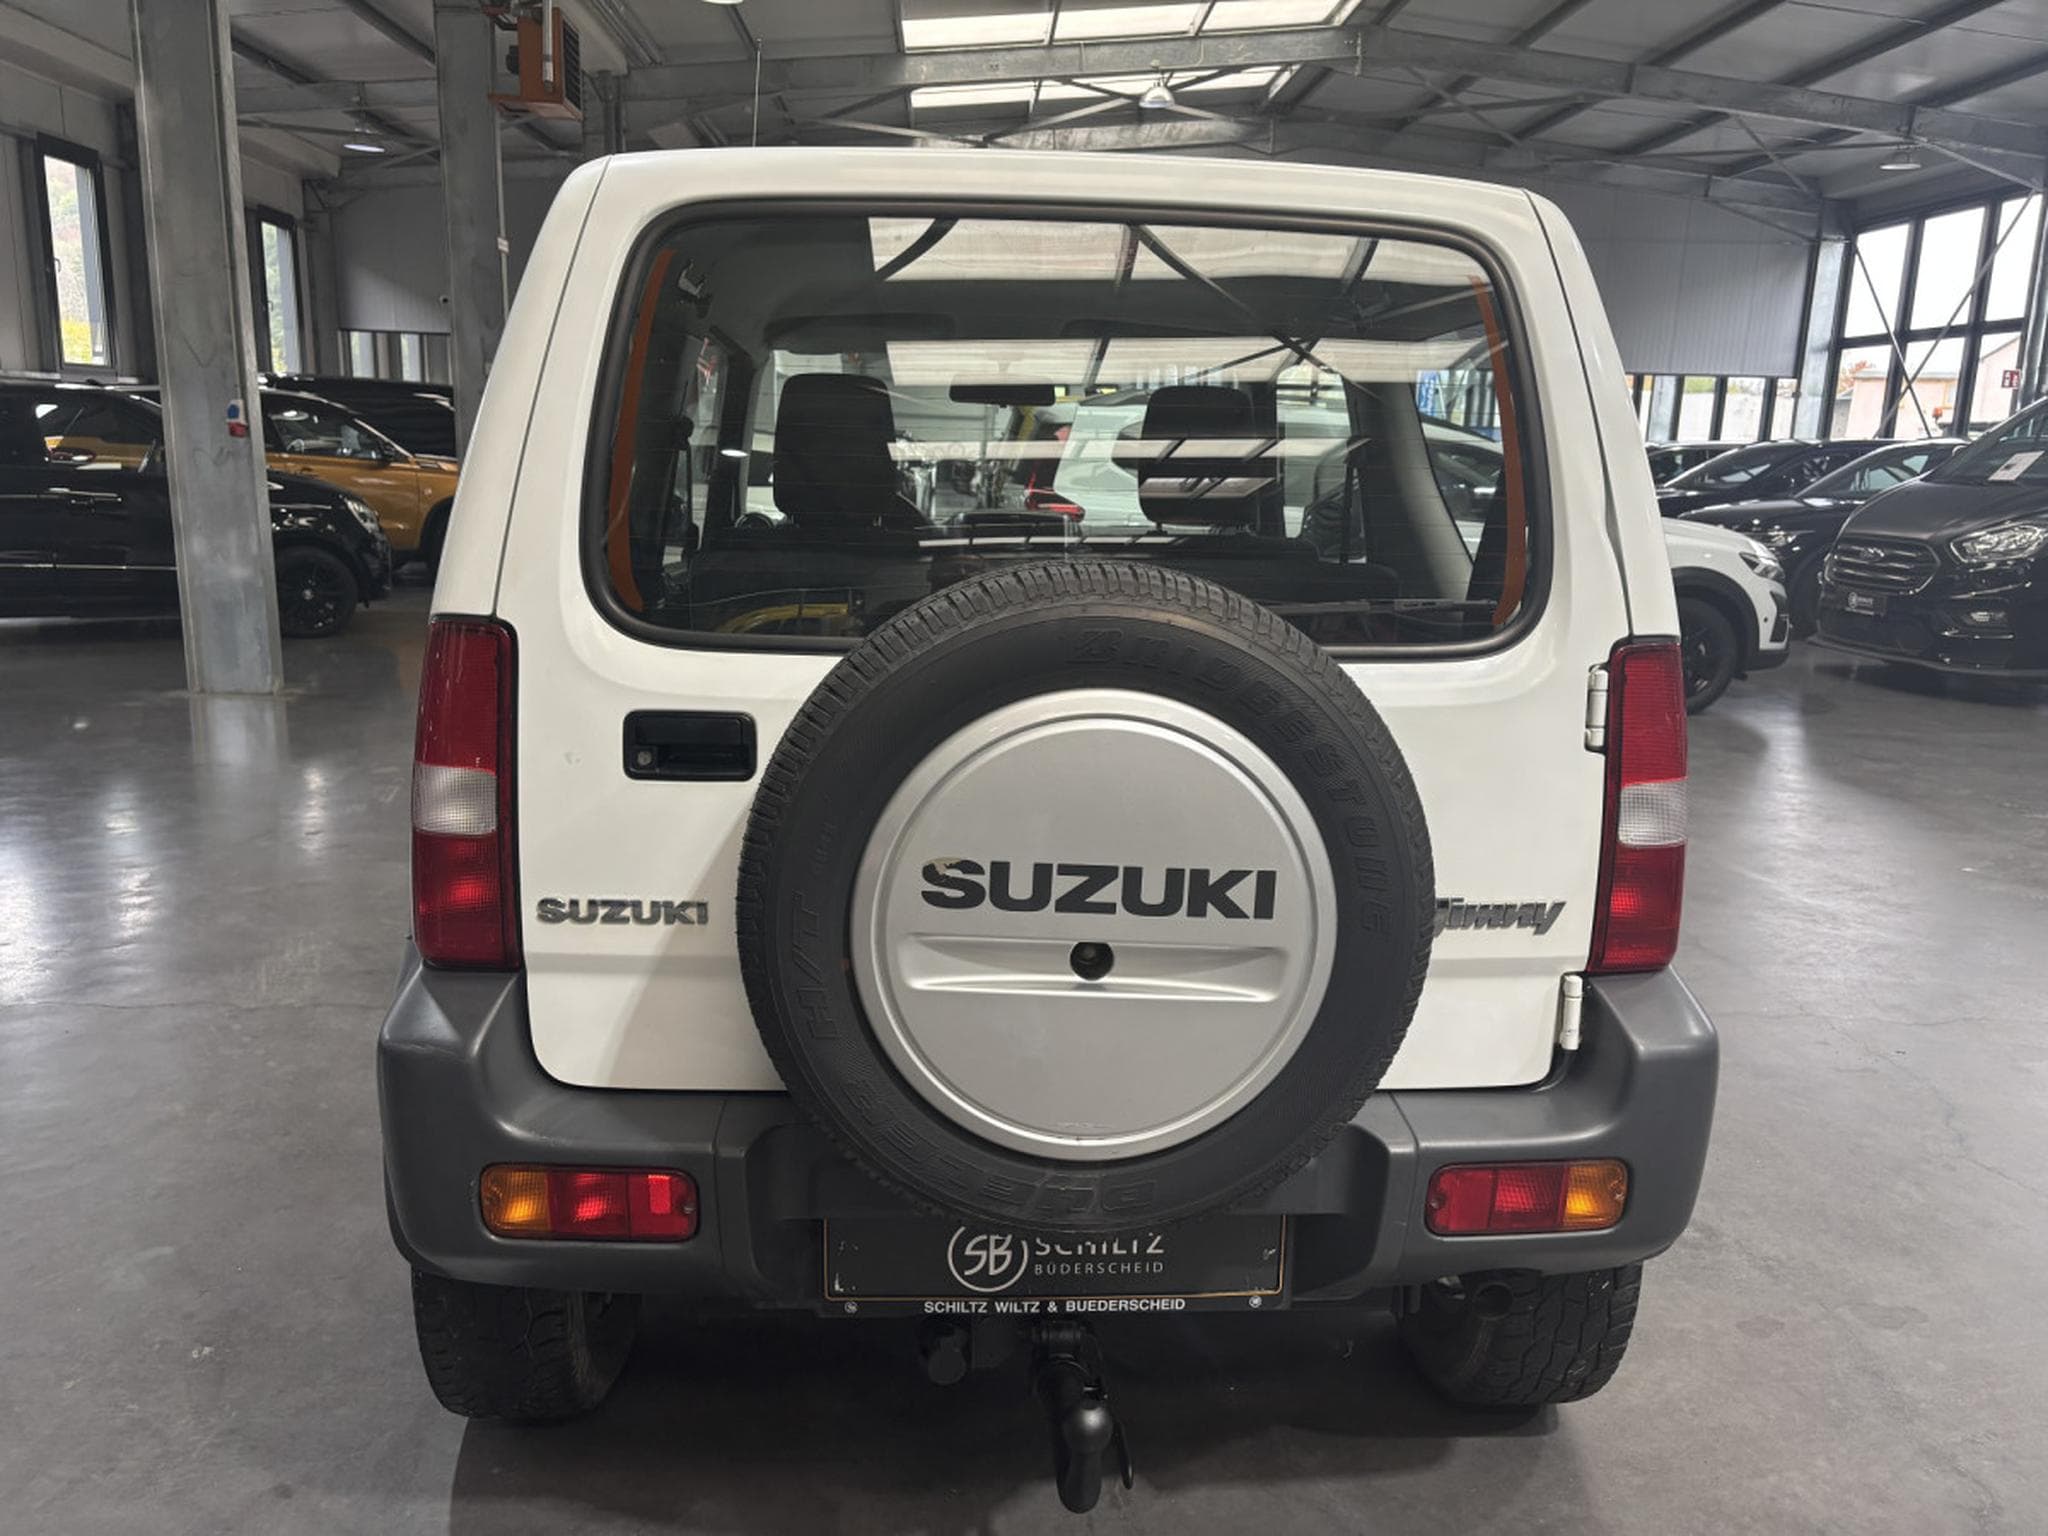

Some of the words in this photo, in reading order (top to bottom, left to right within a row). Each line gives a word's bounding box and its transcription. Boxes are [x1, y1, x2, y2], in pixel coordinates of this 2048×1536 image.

[1064, 626, 1394, 940] BRIDGESTONE
[536, 897, 709, 925] SUZUKI
[920, 856, 1277, 920] SUZUKI
[924, 1301, 988, 1313] SCHILTZ
[994, 1301, 1041, 1313] WILTZ
[1047, 1302, 1059, 1313] &
[1065, 1299, 1186, 1312] BUEDERSCHEID
